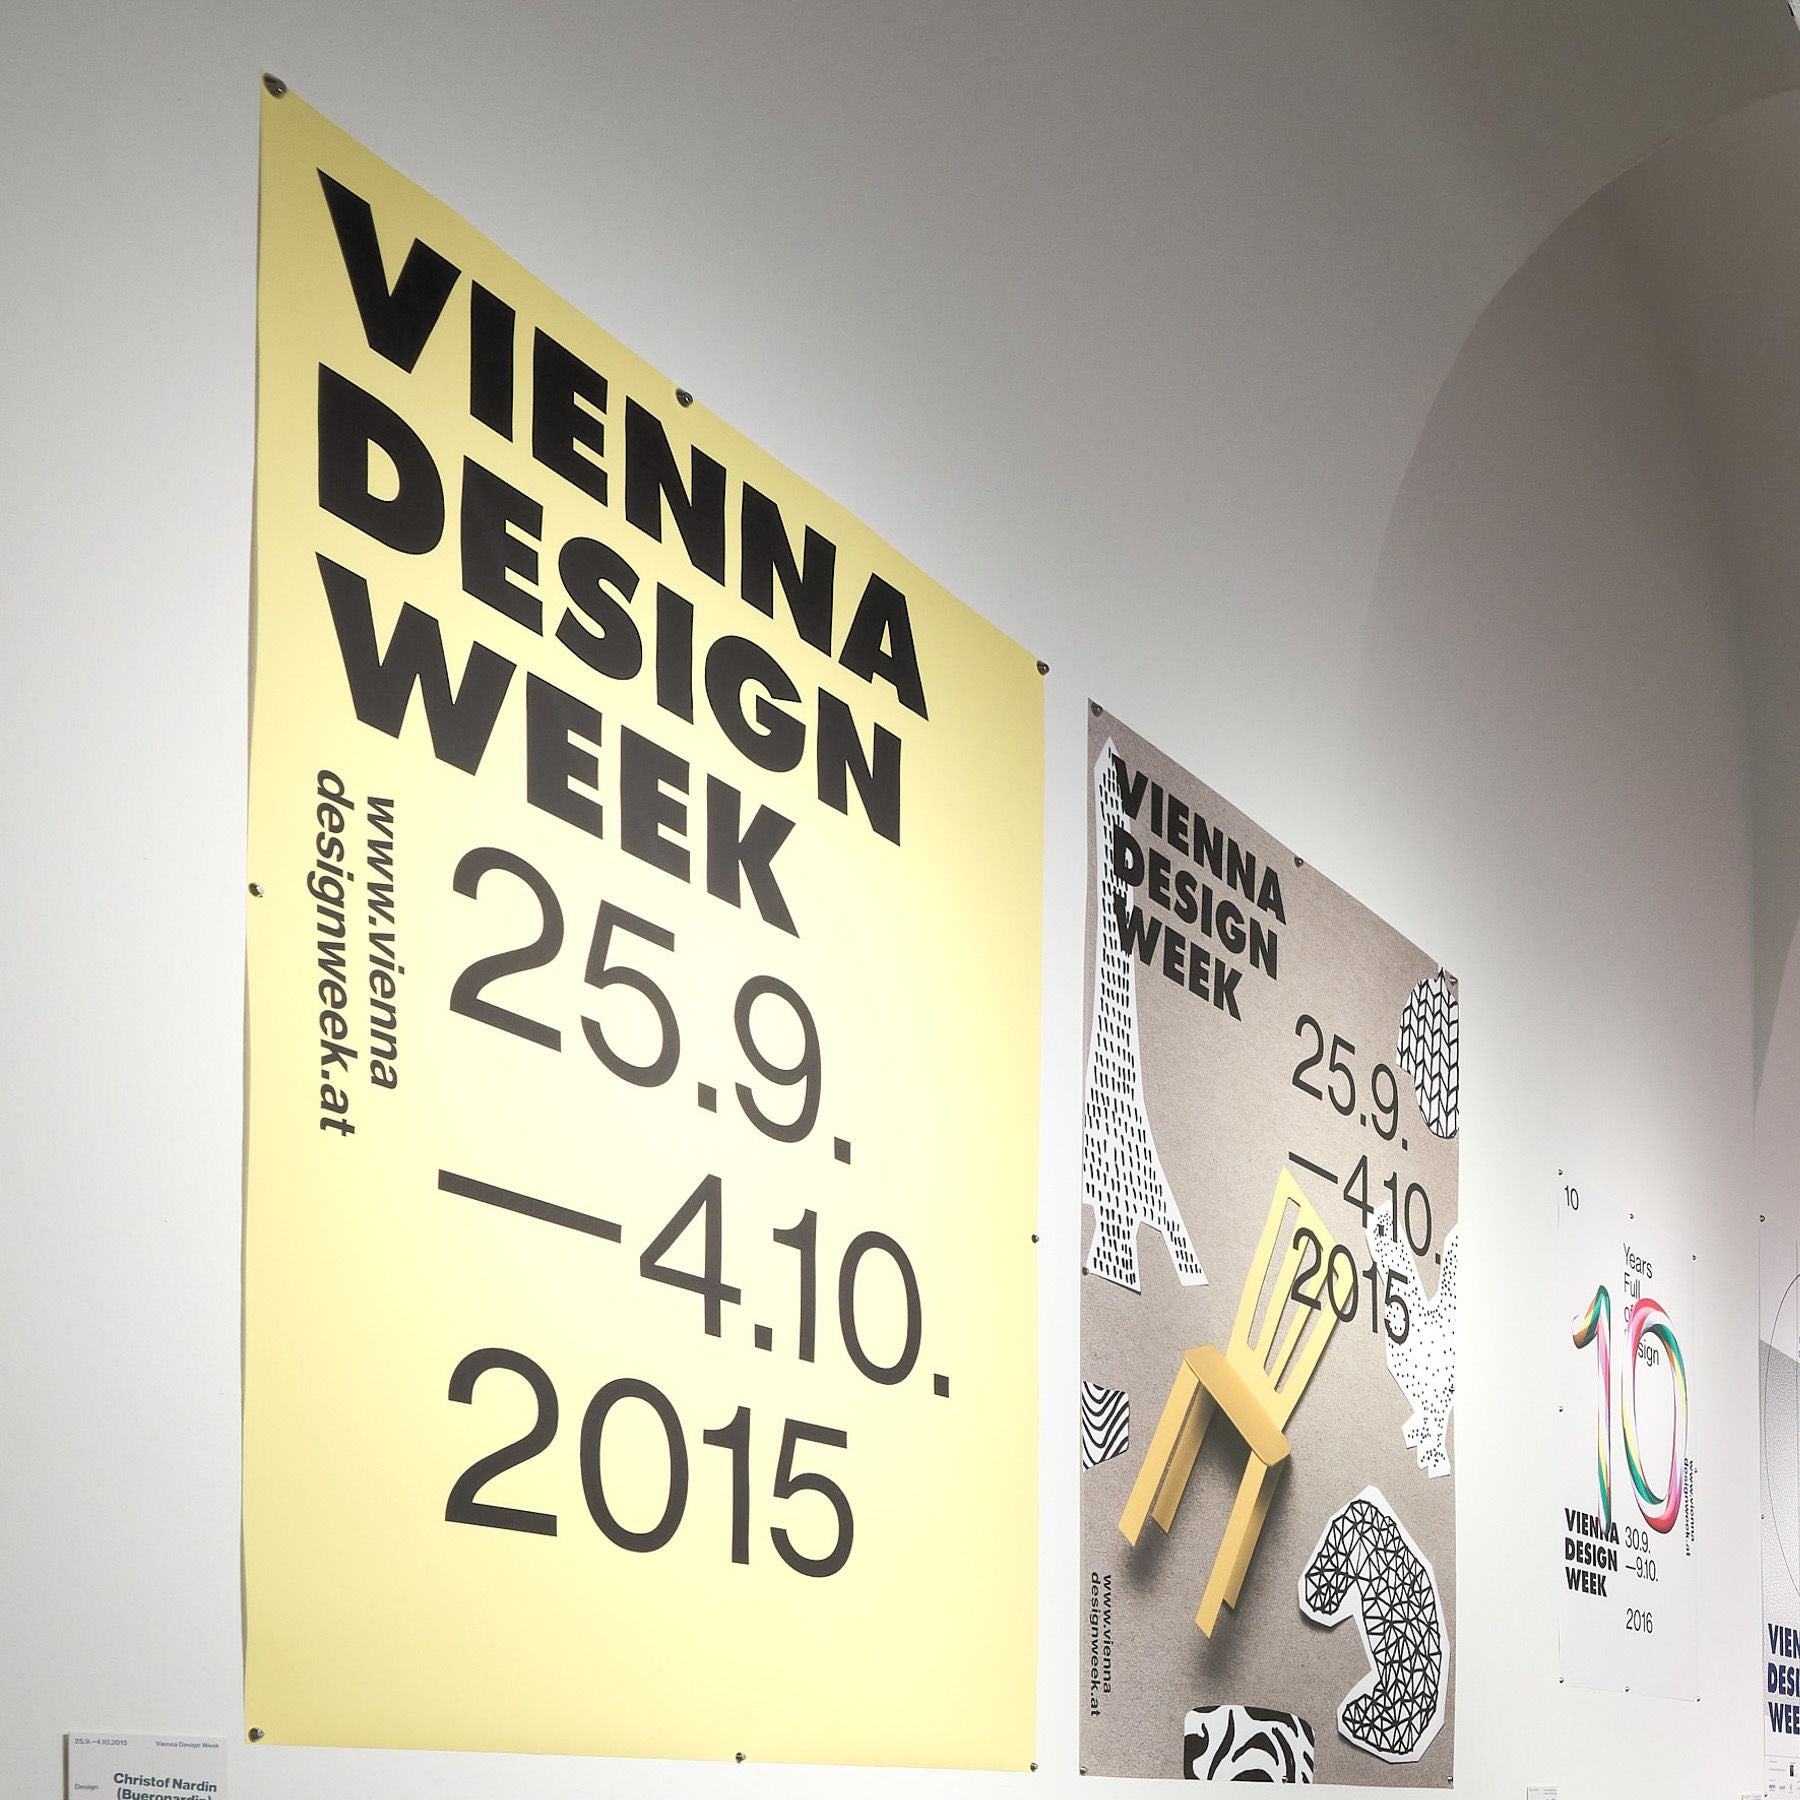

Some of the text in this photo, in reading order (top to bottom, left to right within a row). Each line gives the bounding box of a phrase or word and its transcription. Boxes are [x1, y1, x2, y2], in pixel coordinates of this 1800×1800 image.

[317, 168, 928, 720] VIENNA
[318, 362, 900, 846] DESIGN
[315, 551, 799, 939] WEEK
[1112, 754, 1286, 925] VIENNA
[1112, 824, 1277, 981] DESIGN
[307, 768, 355, 1136] designweek.at
[366, 796, 405, 1091] www.vienna
[450, 847, 851, 1165] 25.9.
[1112, 891, 1242, 1022] WEEK
[1291, 1014, 1408, 1151] 25.9.
[1564, 1185, 1579, 1211] 10
[1623, 1242, 1653, 1279] Years
[1290, 1227, 1410, 1344] 2015
[1623, 1272, 1641, 1300] Full
[445, 1348, 854, 1578] 2015
[1564, 1537, 1618, 1572] DESIGN
[1565, 1566, 1608, 1597] WEEK
[1624, 1526, 1650, 1554] 30.9.
[1091, 1571, 1101, 1717] designweek.at
[1103, 1574, 1112, 1694] www.vienna
[1626, 1608, 1653, 1633] 2016
[75, 1783, 99, 1791] Design
[113, 1772, 217, 1793] Christof Nardin
